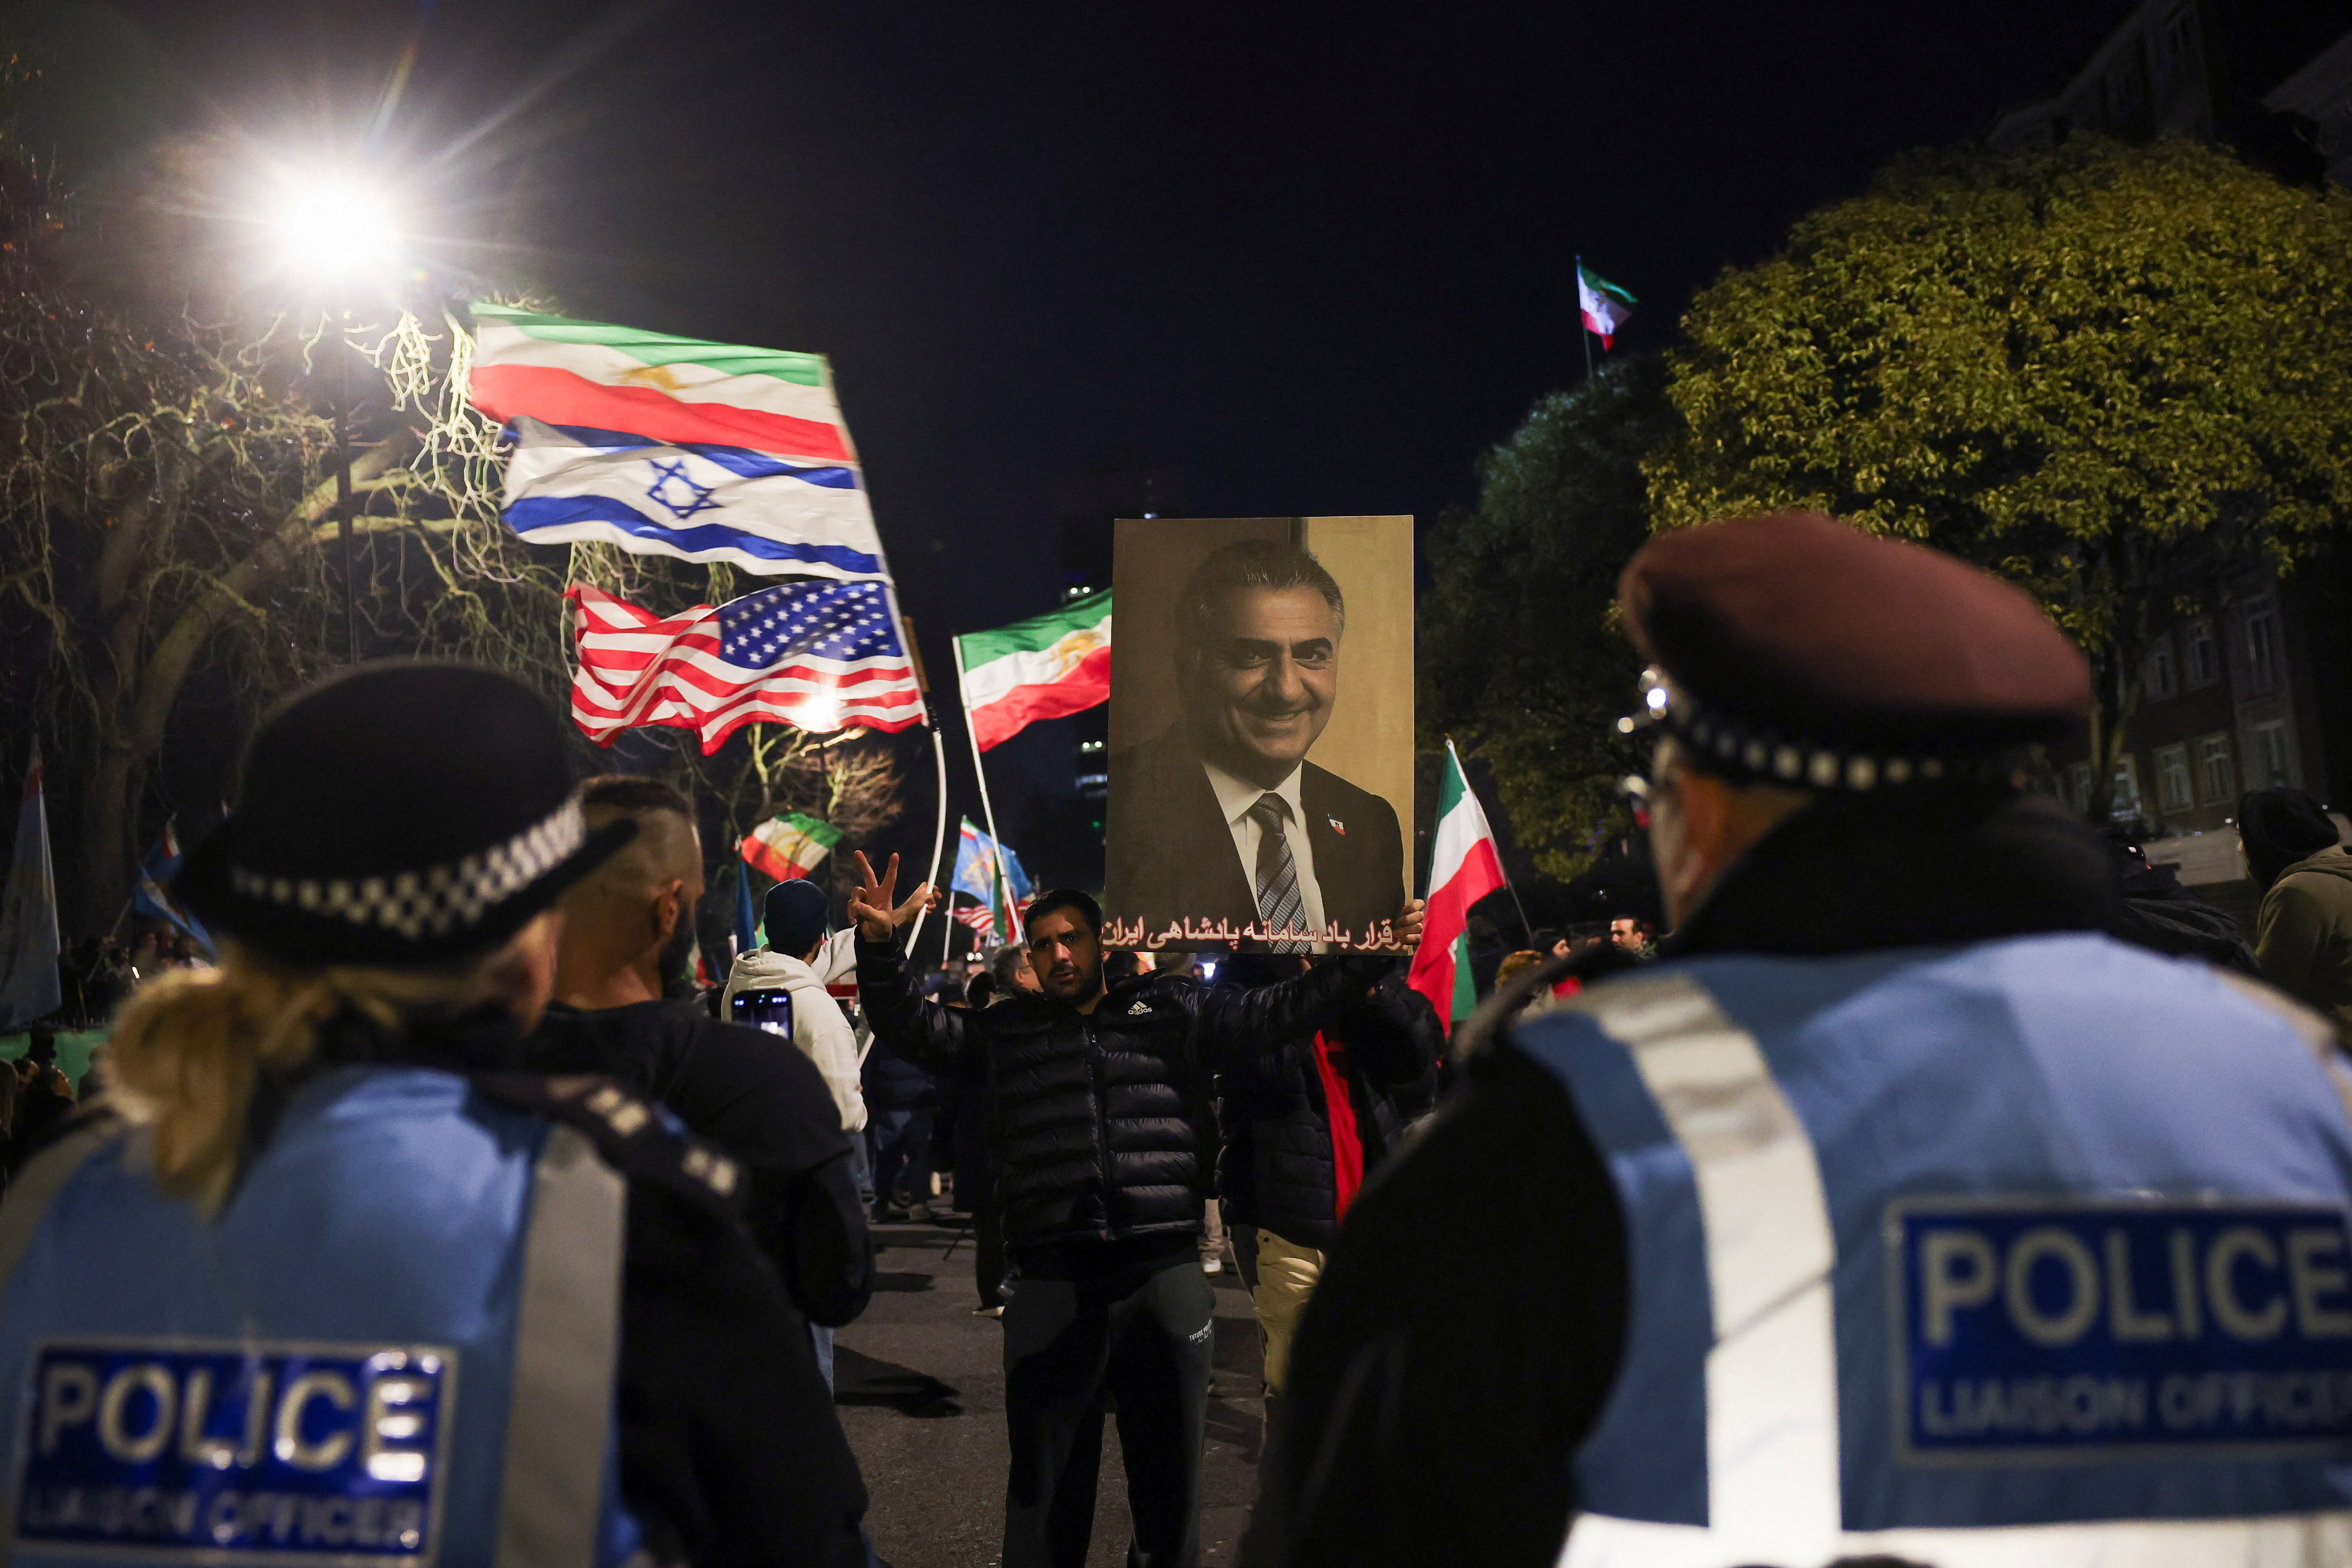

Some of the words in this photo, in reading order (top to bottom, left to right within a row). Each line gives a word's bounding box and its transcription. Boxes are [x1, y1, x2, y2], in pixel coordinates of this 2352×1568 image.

[1099, 915, 1145, 946] ایران
[1146, 915, 1240, 950] پادشاهی
[1243, 918, 1318, 942] سامانه
[1322, 919, 1350, 950] باد
[1919, 1227, 2352, 1347] POLICE
[1189, 1329, 1204, 1342] FUTURE
[40, 1362, 426, 1482] POLICE
